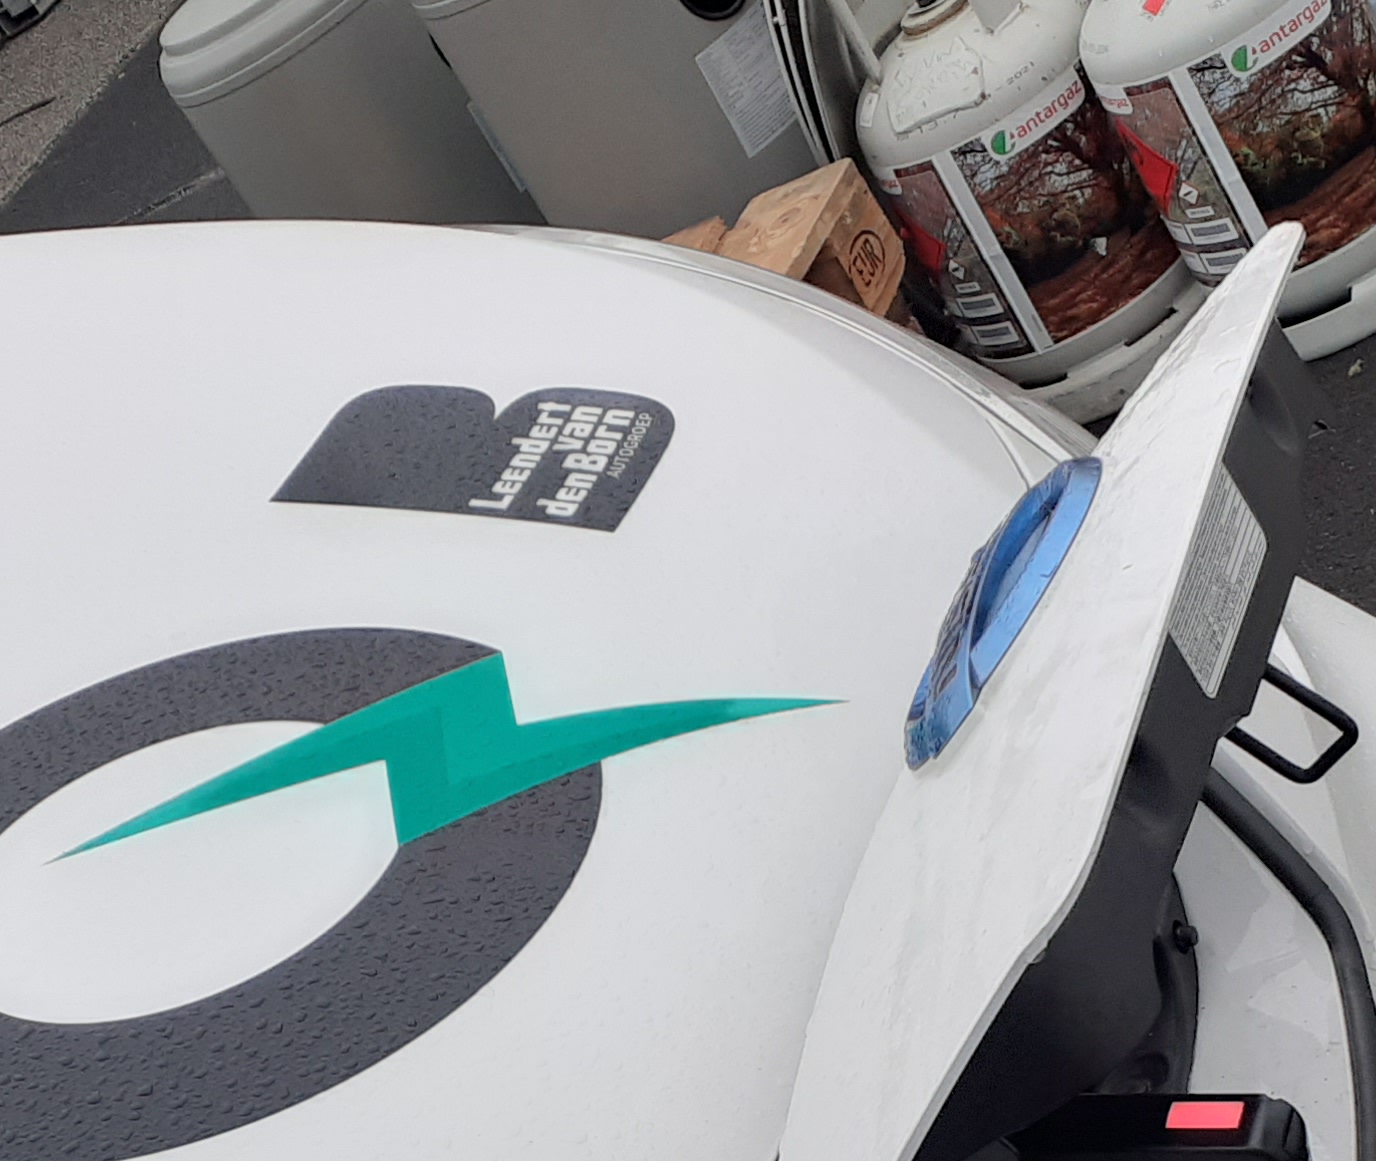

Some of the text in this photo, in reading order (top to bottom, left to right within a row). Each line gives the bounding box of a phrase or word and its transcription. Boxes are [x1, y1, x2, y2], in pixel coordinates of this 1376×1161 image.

[1006, 60, 1036, 86] 2021
[1016, 79, 1083, 138] antargaz
[852, 237, 882, 288] EUR
[553, 405, 603, 452] van
[606, 412, 653, 479] AUTOGROEP
[469, 402, 573, 511] Leendert
